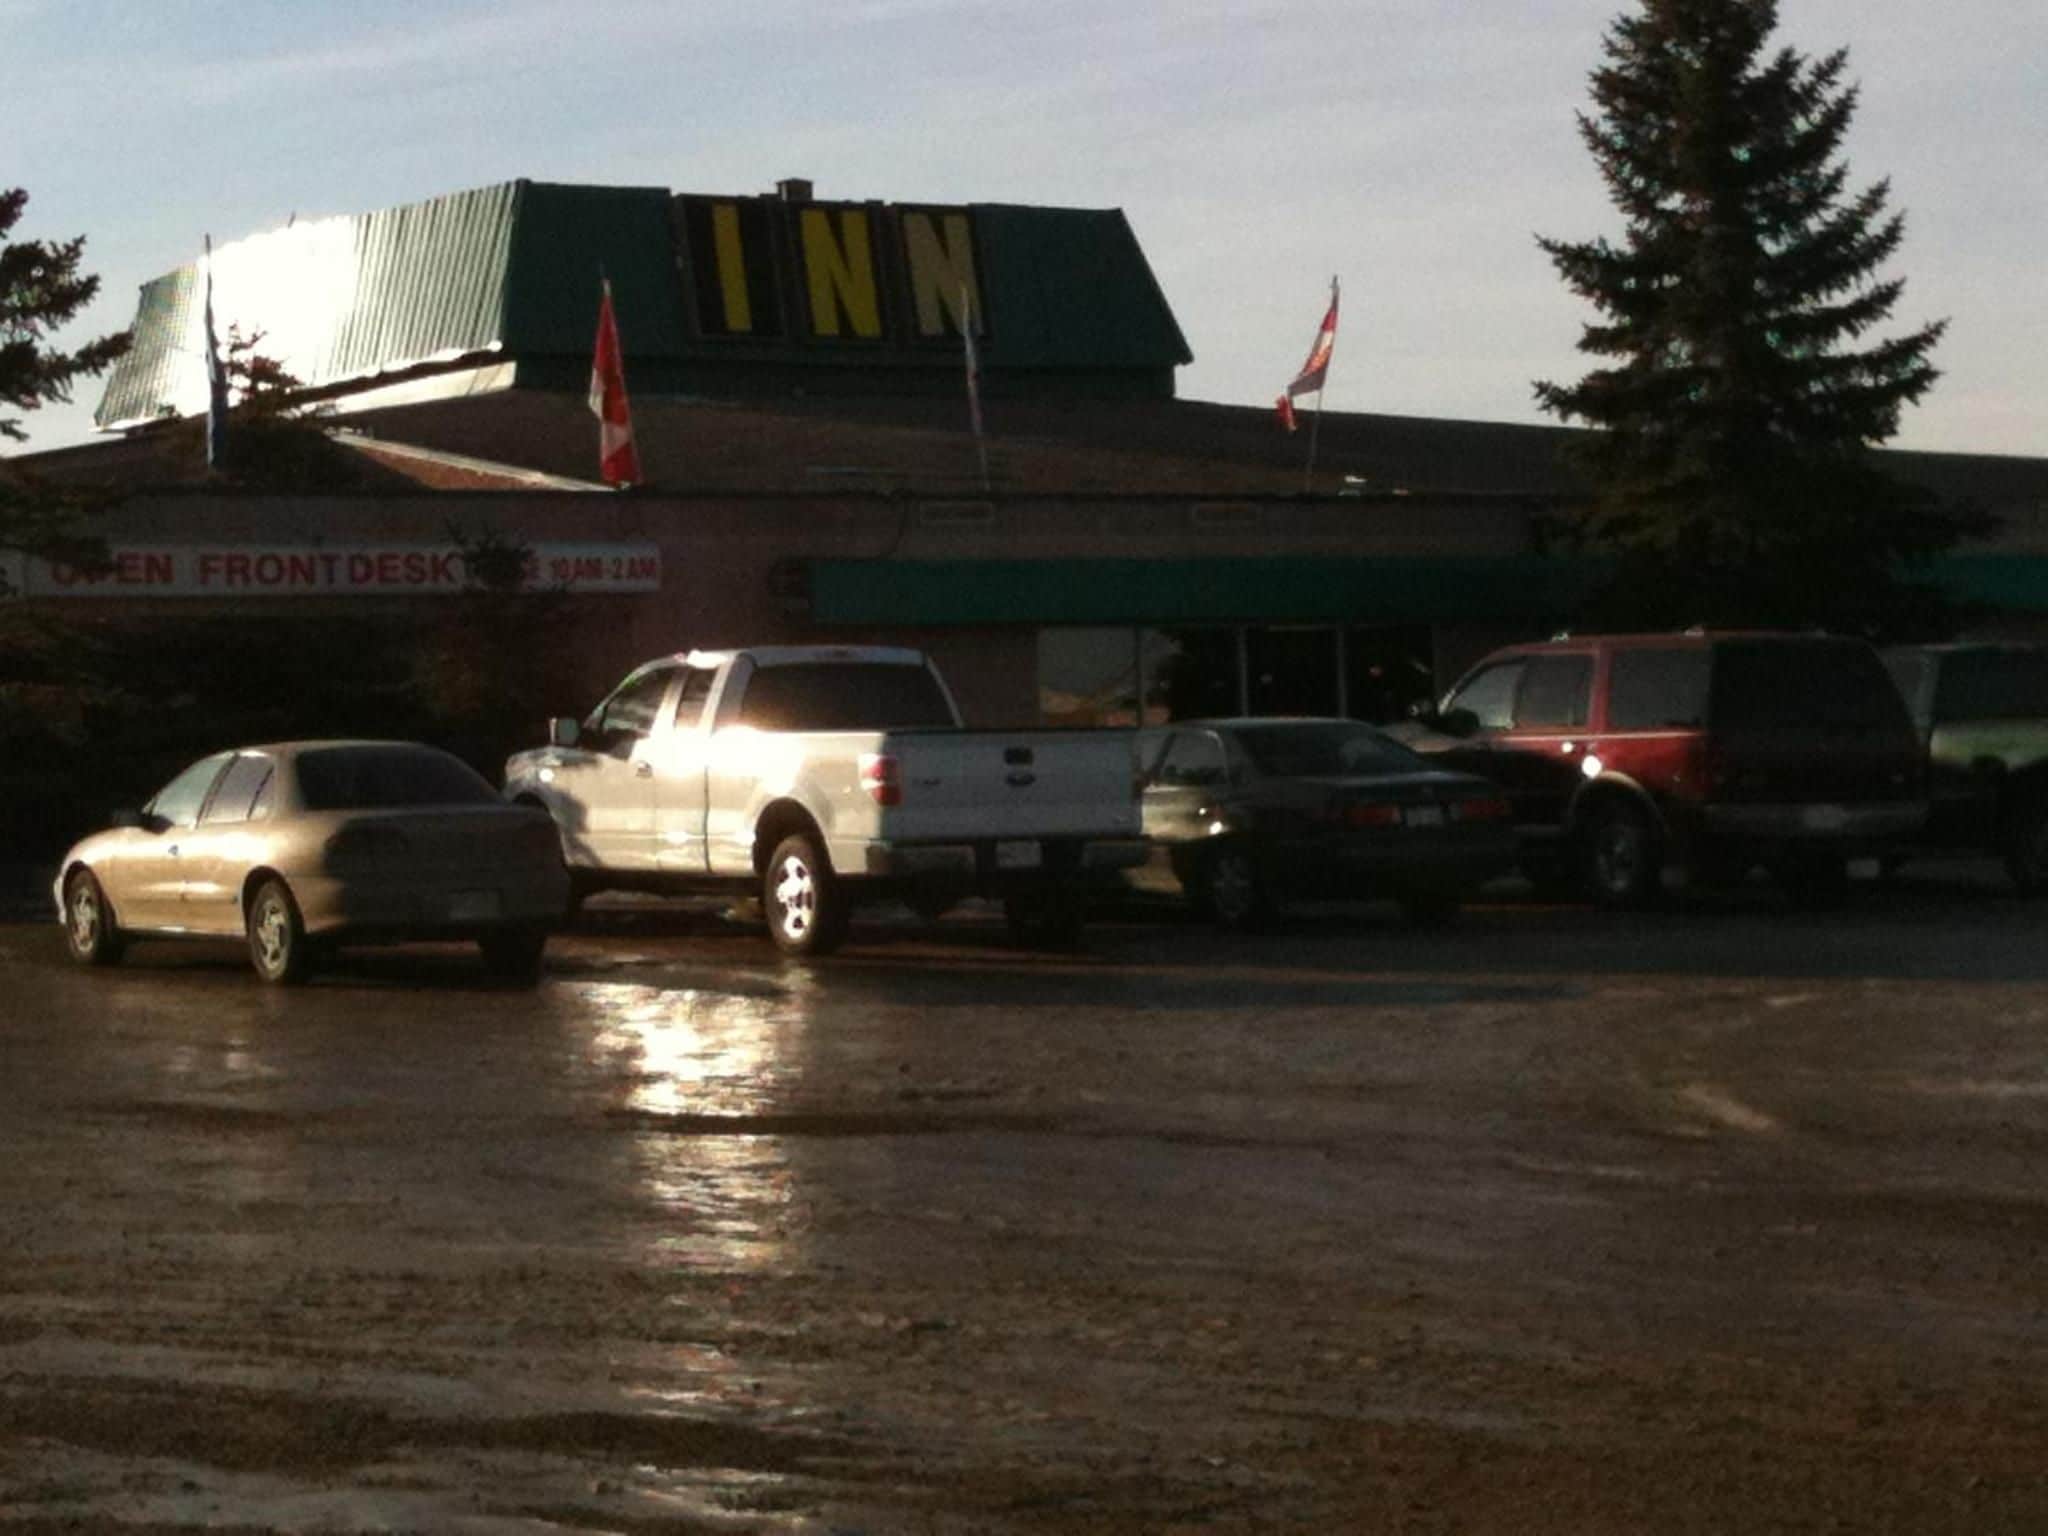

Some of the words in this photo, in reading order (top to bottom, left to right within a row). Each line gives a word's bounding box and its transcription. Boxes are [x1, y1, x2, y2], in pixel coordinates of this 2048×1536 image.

[712, 205, 984, 336] INN
[201, 552, 341, 585] FRONT
[349, 552, 462, 585] DESK
